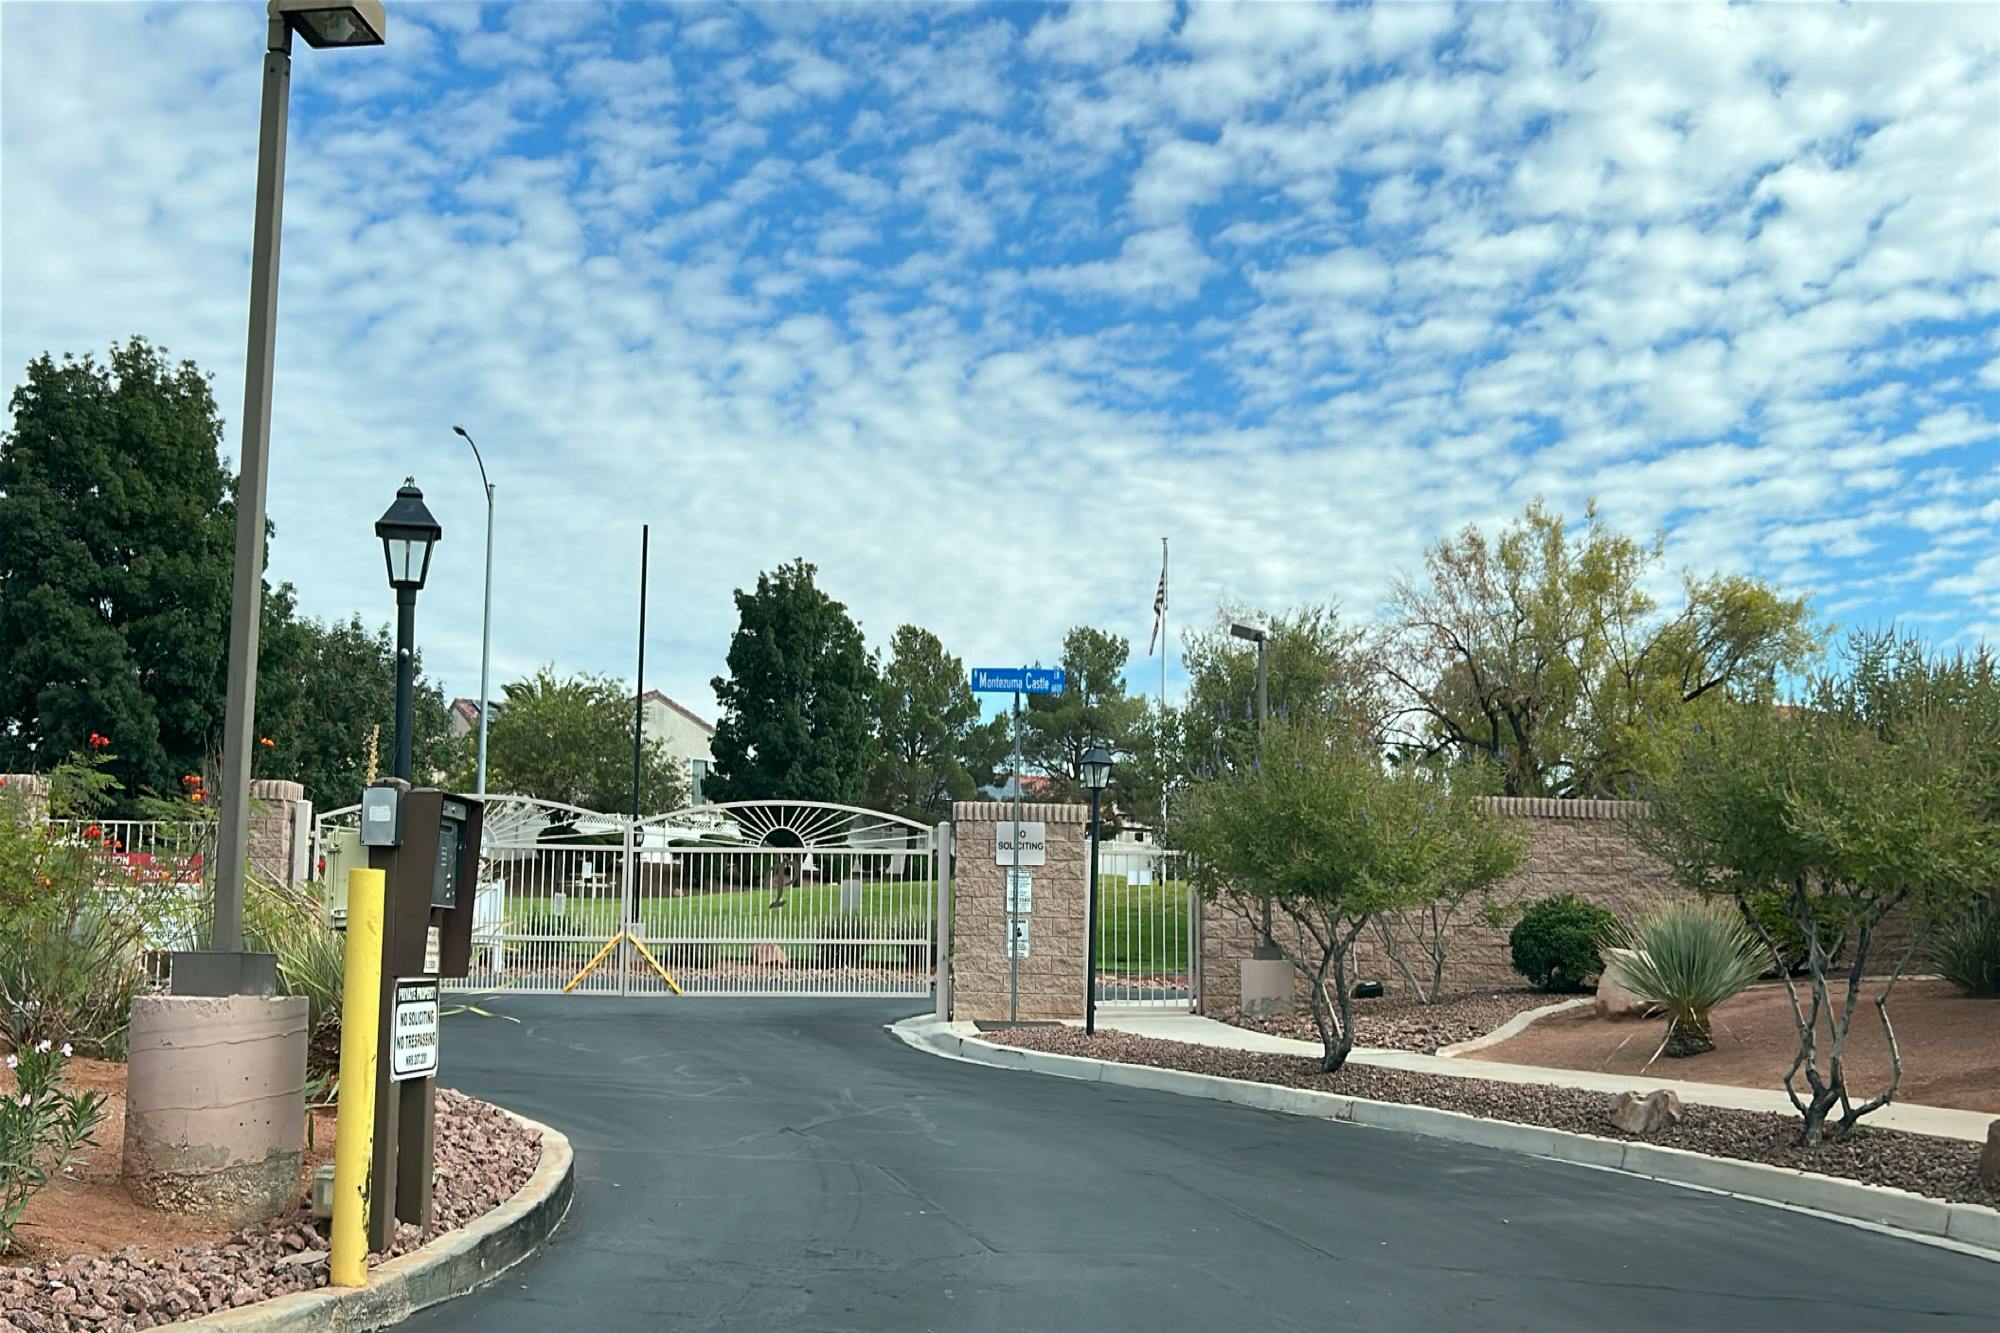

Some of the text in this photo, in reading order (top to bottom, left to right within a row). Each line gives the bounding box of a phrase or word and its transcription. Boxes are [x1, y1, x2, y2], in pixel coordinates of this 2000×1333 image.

[979, 671, 1022, 689] Montezuma
[1025, 672, 1050, 690] Castle
[998, 841, 1044, 850] SOLCITING
[400, 1010, 434, 1026] NO SOLICITING
[396, 1032, 436, 1050] NO TRESPASSING
